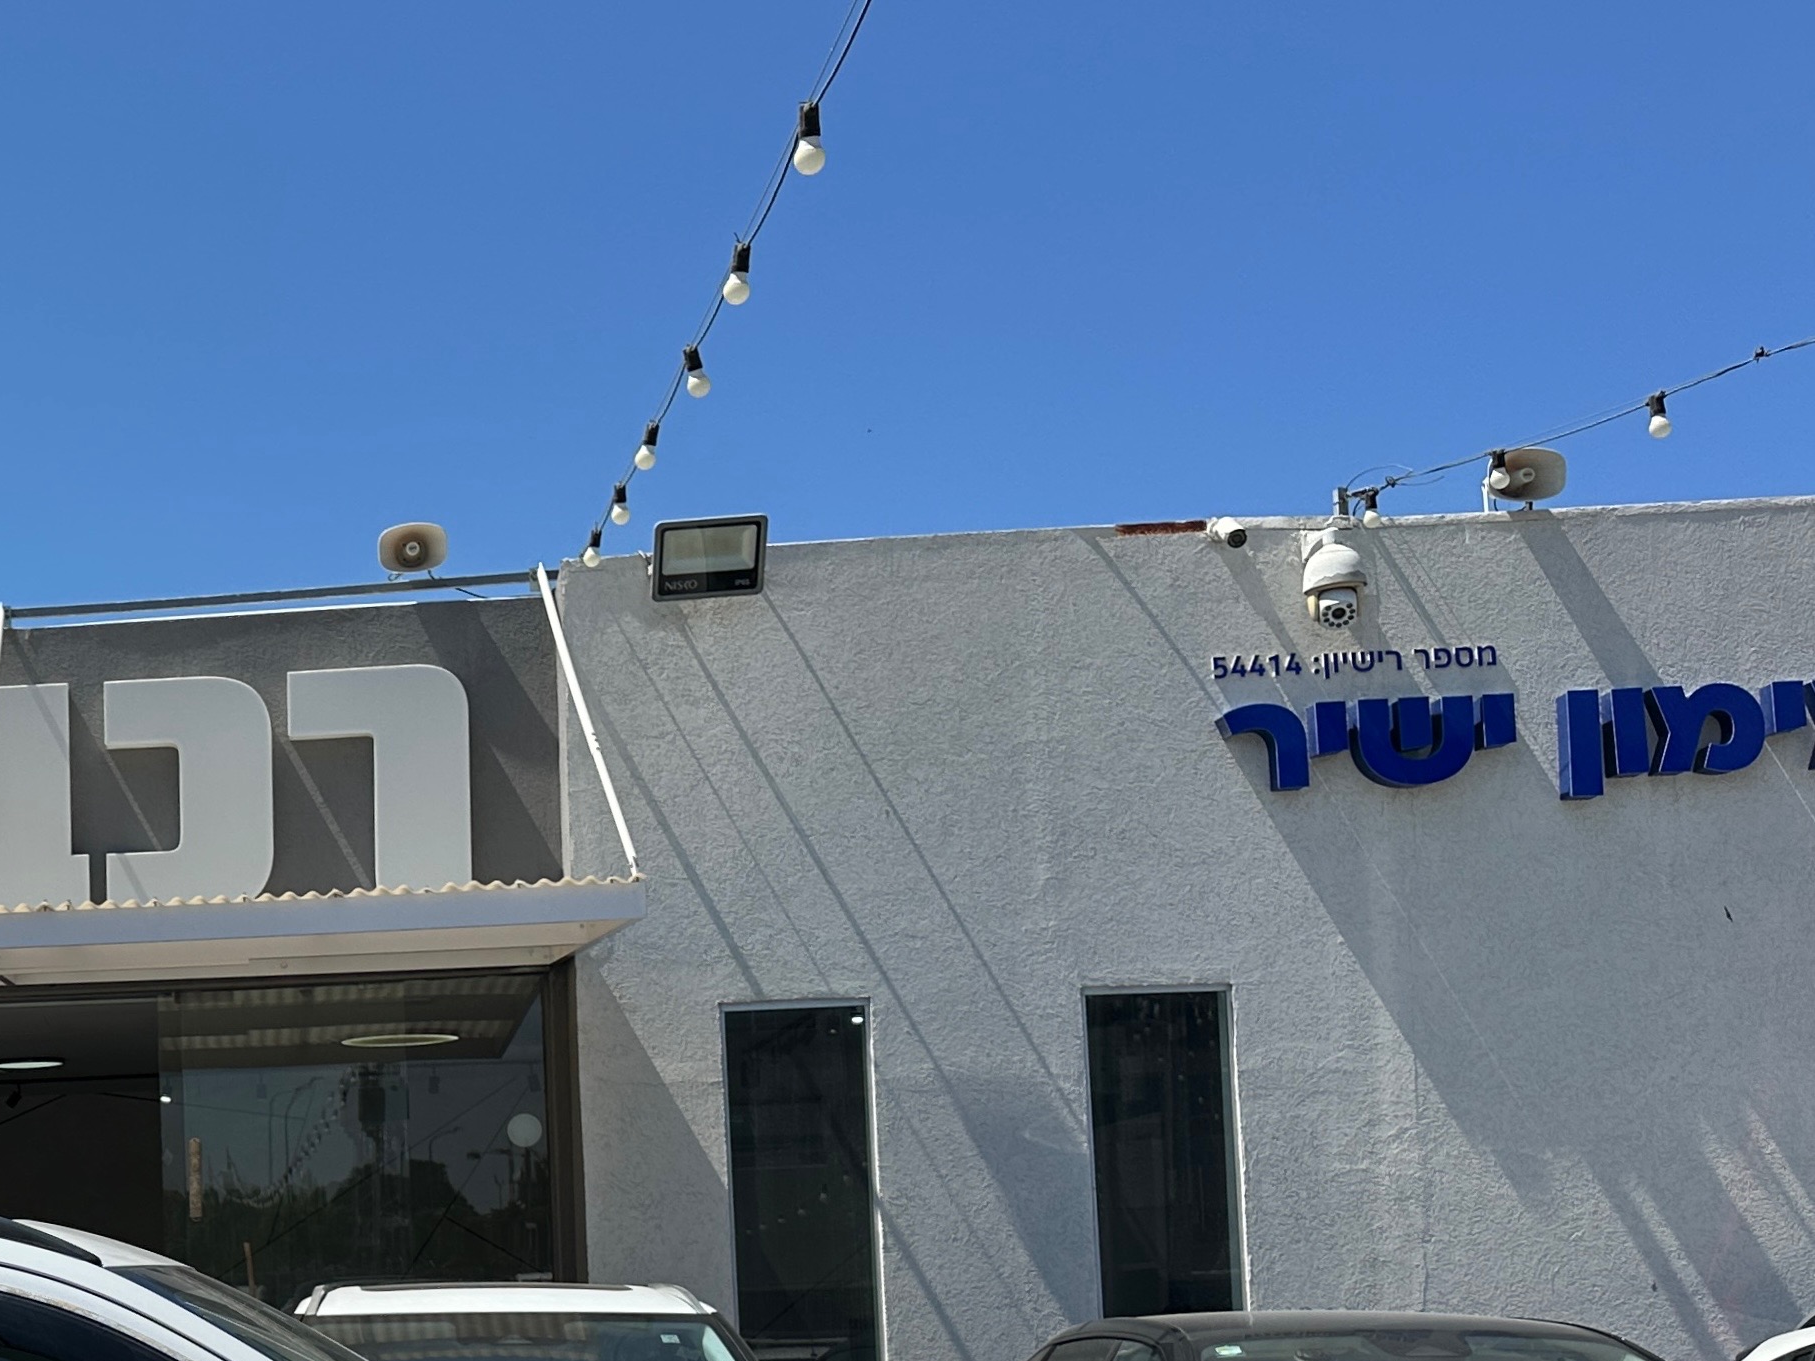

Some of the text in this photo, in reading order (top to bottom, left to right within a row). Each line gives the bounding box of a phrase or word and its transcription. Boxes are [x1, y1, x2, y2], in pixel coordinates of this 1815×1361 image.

[1211, 644, 1498, 680] מספר רישיון: 54414
[1215, 679, 1815, 801] ימון ישיר
